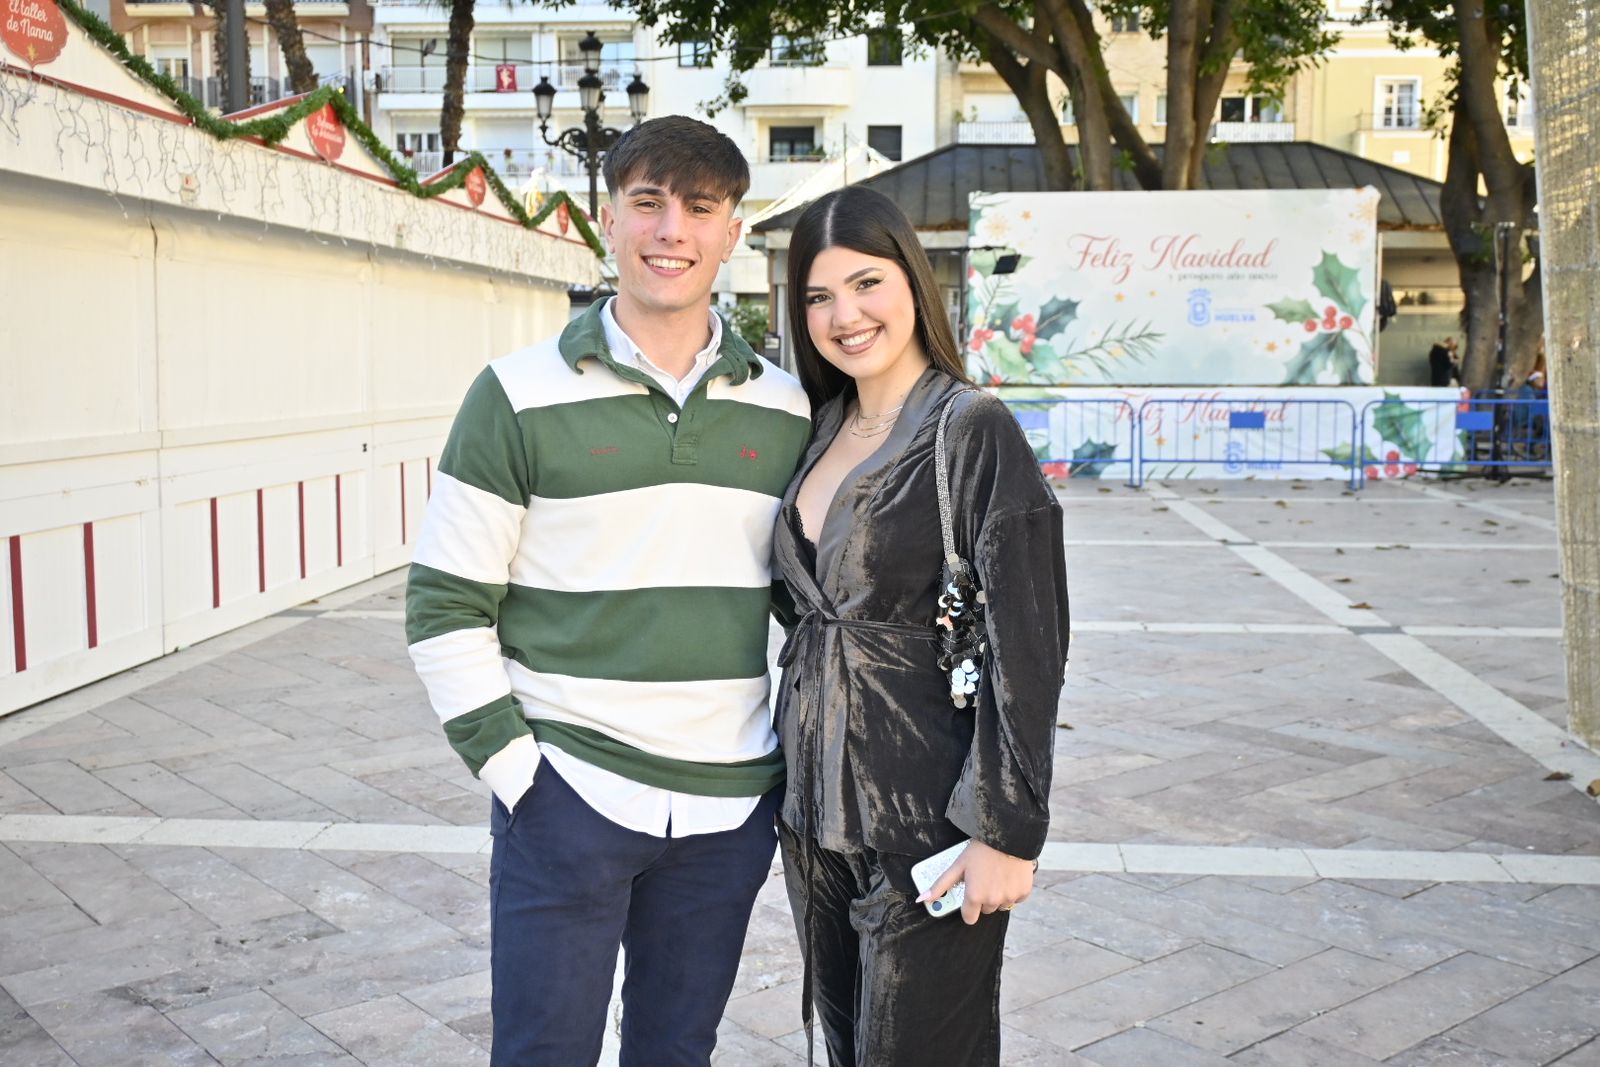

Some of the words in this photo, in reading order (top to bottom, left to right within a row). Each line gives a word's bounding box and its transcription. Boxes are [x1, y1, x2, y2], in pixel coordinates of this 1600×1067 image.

[20, 0, 48, 22] taller
[6, 14, 19, 32] de
[20, 18, 54, 42] Nanna
[1067, 233, 1135, 284] Feliz
[1143, 233, 1279, 271] Navidad
[1215, 314, 1256, 322] HUELVA
